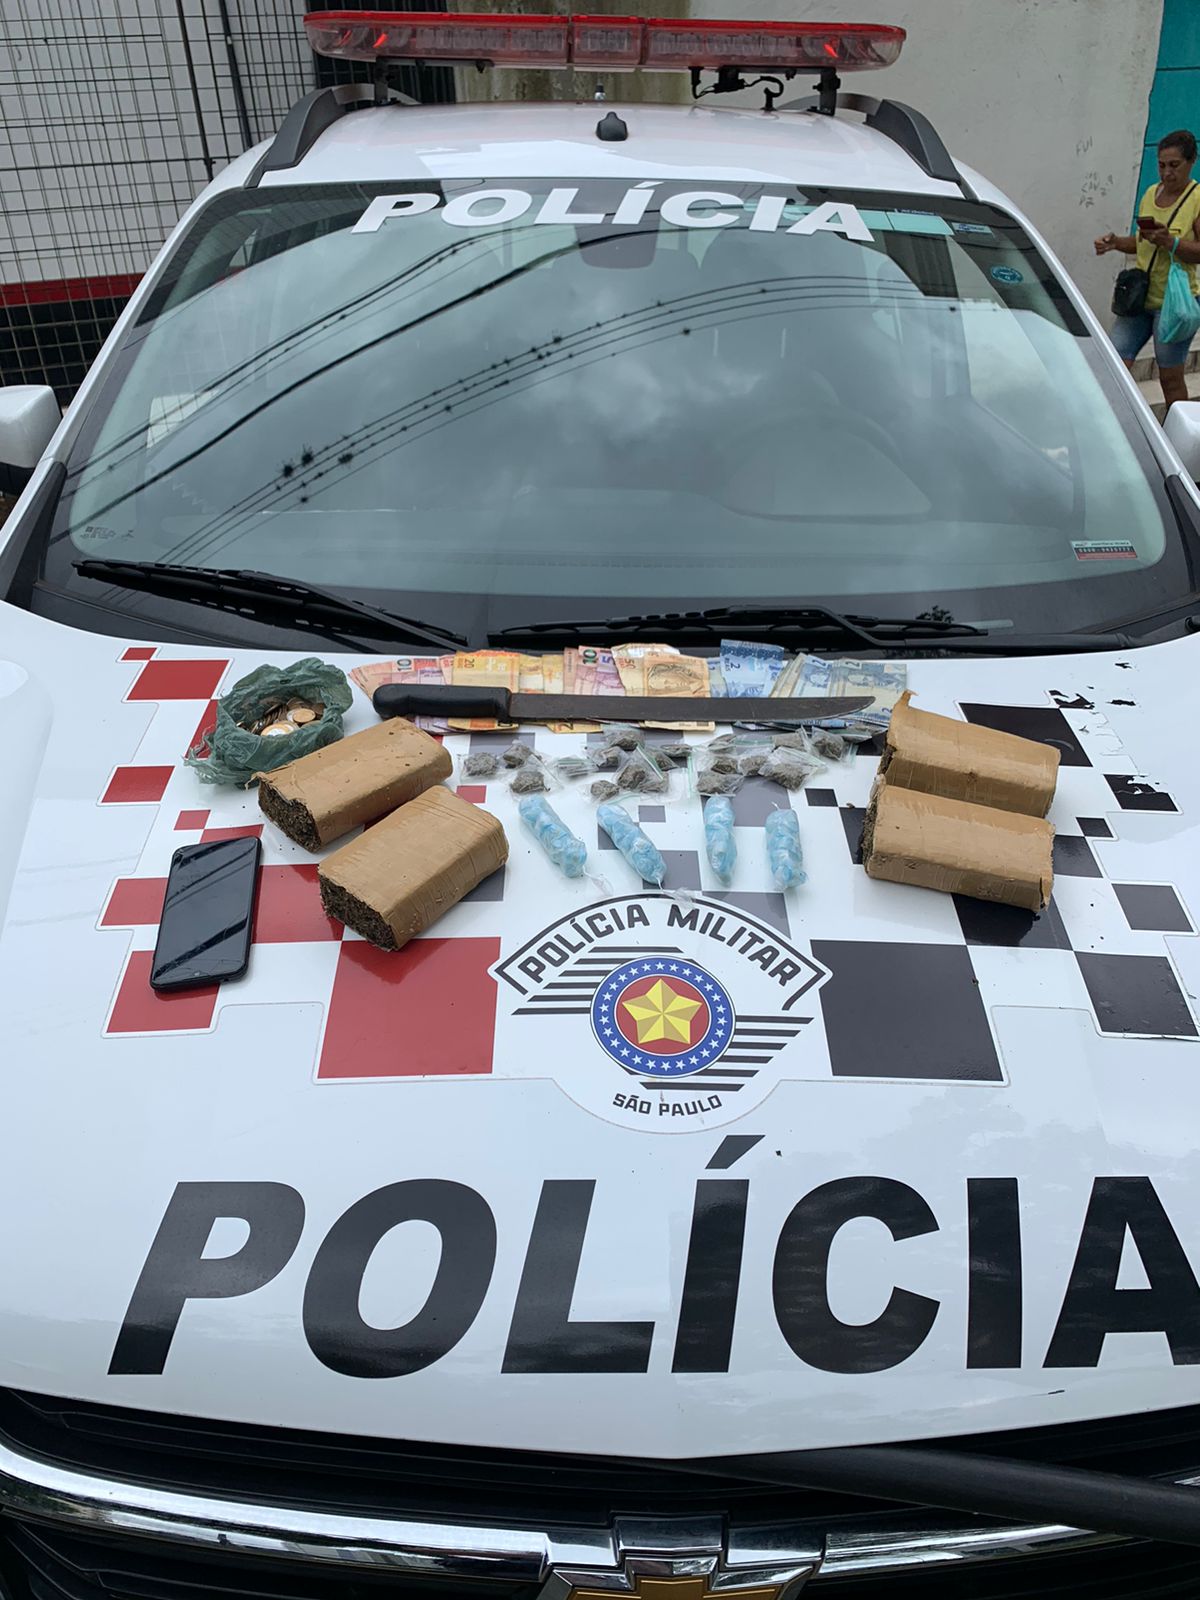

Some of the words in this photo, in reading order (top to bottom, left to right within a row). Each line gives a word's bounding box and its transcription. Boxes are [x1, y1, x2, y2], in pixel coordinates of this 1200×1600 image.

[351, 181, 875, 242] POLÍCIA
[397, 658, 412, 672] 10
[464, 658, 475, 669] 20
[582, 649, 597, 664] 10
[517, 903, 650, 984] POLÍCIA
[667, 903, 802, 987] MILITAR
[612, 1093, 651, 1116] SÃO
[658, 1094, 723, 1117] PAULO
[106, 1134, 1200, 1378] POLÍCIA
